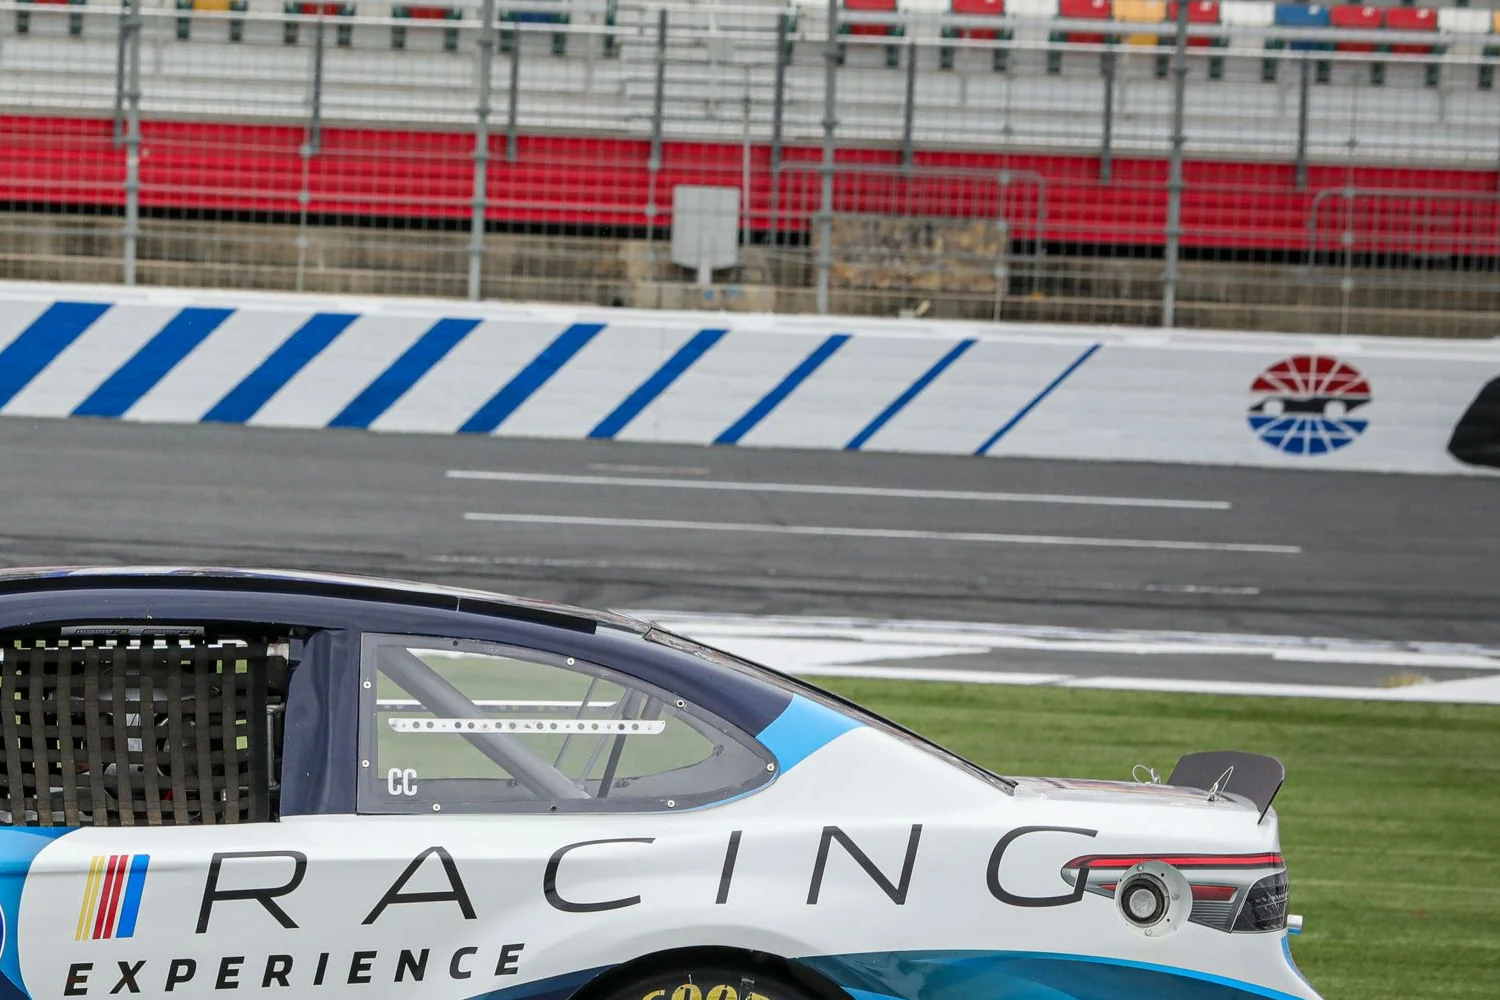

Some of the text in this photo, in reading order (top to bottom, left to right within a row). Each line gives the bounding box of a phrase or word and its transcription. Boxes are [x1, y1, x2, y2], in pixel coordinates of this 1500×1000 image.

[388, 768, 418, 796] CC
[195, 824, 1098, 934] RACING
[63, 942, 526, 997] EXPERIENCE
